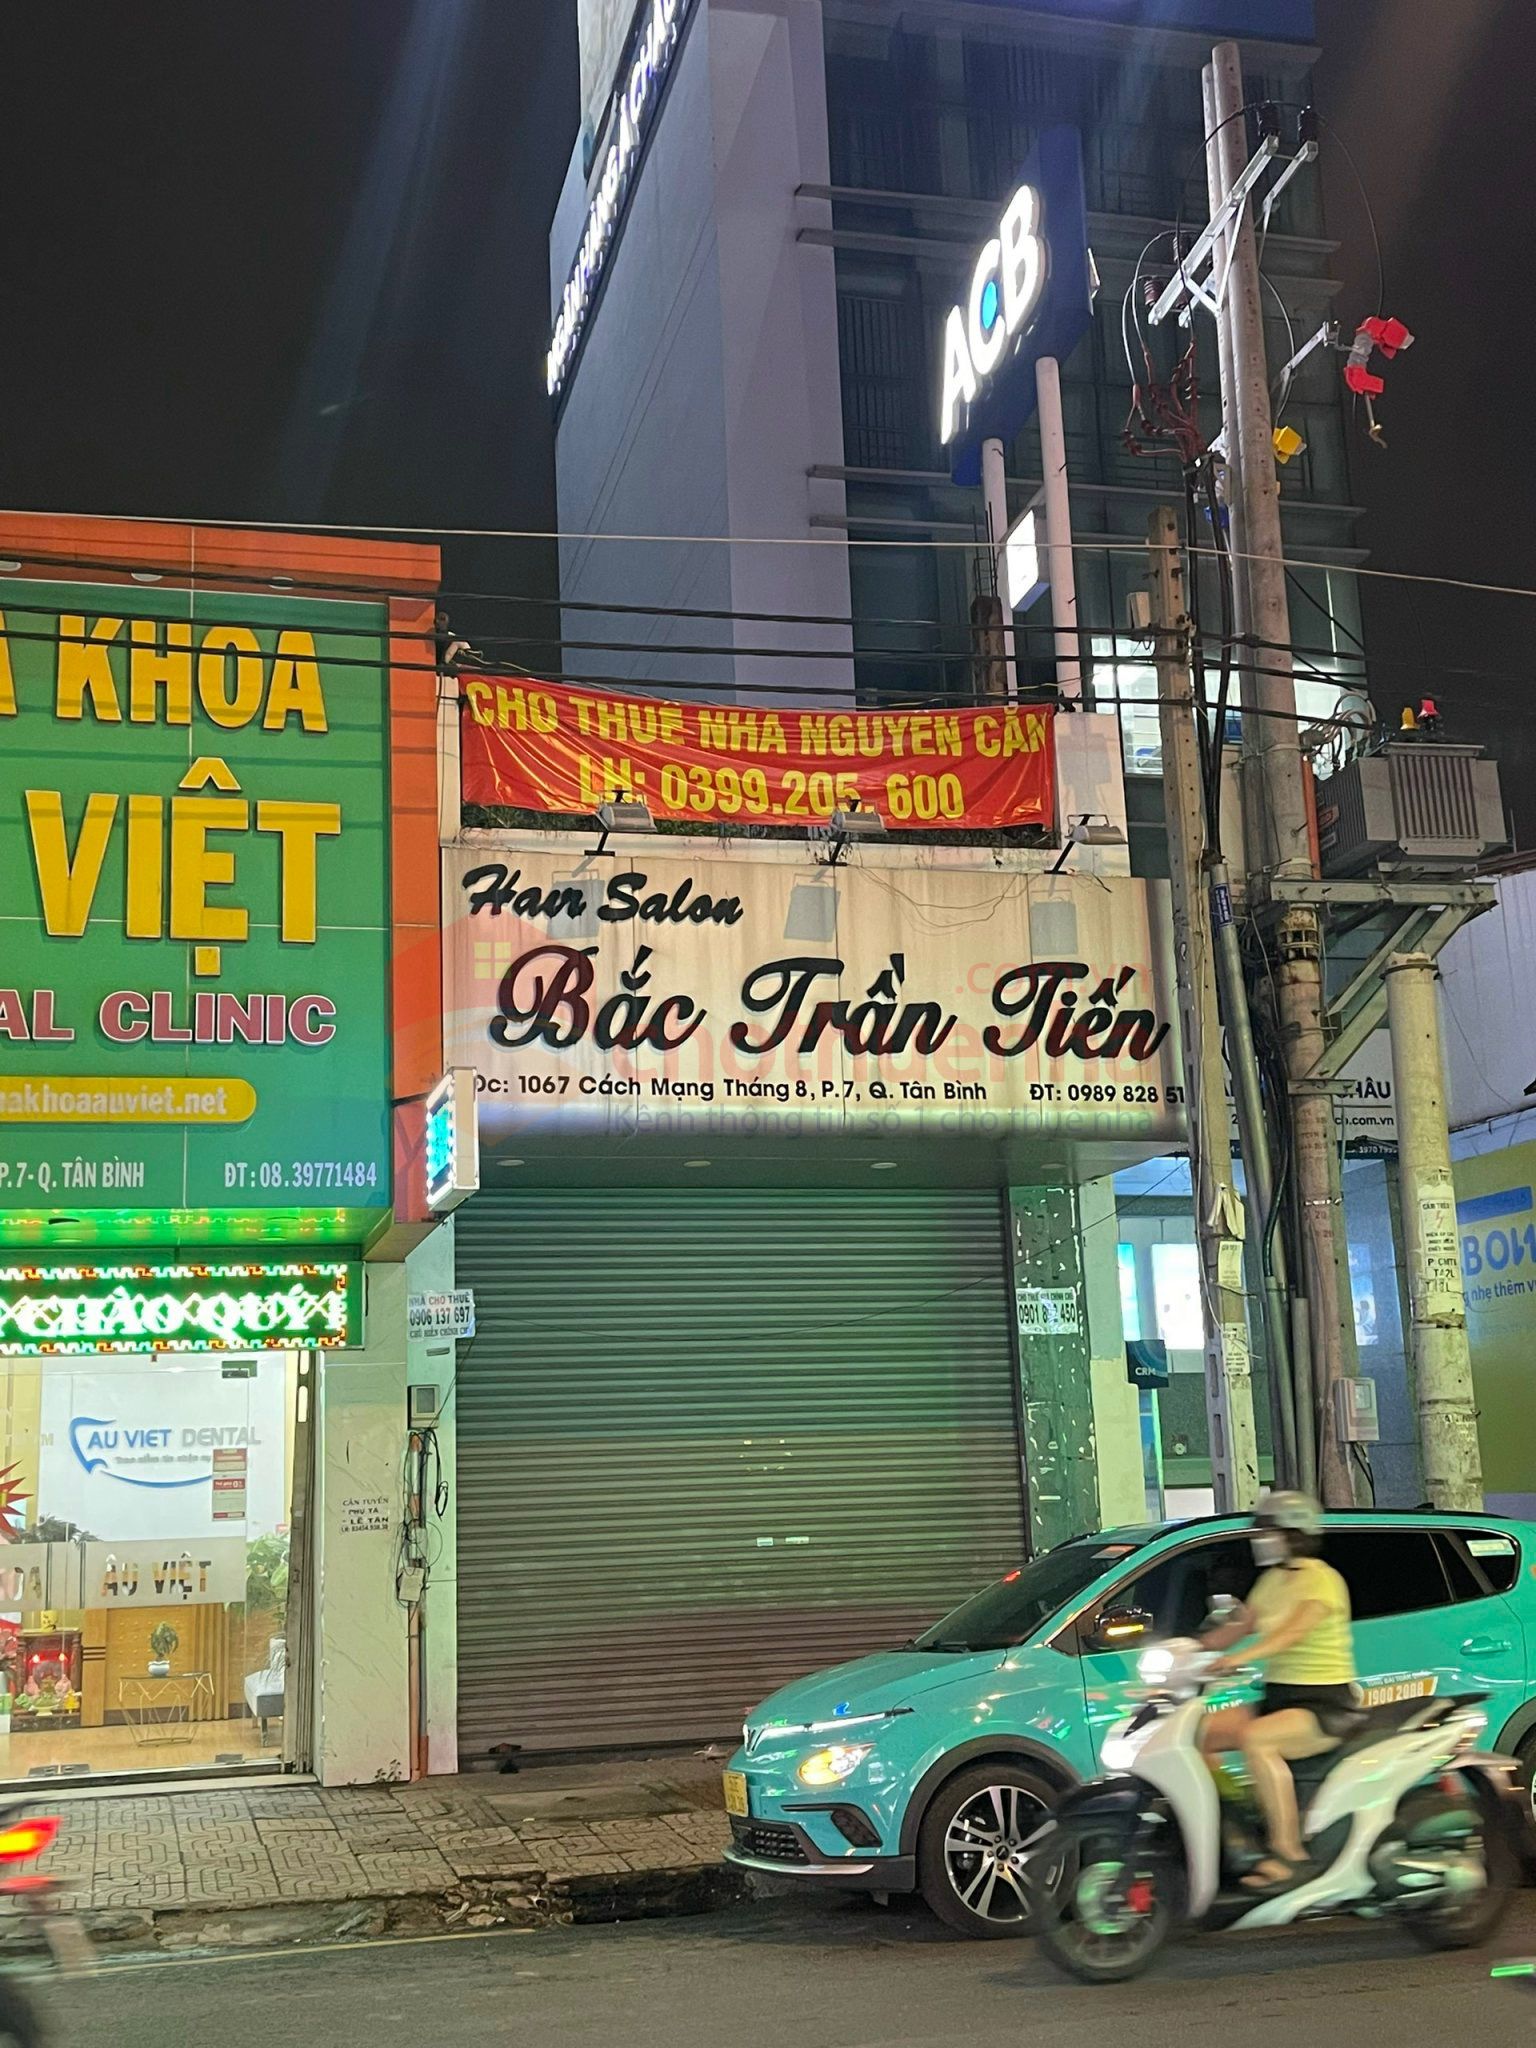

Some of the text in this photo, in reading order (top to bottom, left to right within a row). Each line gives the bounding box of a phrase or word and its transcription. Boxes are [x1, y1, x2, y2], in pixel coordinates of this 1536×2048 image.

[941, 185, 1040, 445] ACB
[57, 614, 328, 733] KHOA
[466, 682, 558, 733] CHO
[569, 700, 686, 745] THUÊ
[973, 706, 1047, 757] CĂN
[887, 774, 965, 820] 600
[25, 756, 341, 976] VIỆT
[462, 863, 744, 926] Hair Salon
[99, 990, 337, 1046] CLINIC
[488, 945, 1171, 1061] Bắc Trần Tiến
[518, 1075, 569, 1094] 1067
[578, 1073, 640, 1096] Cách
[651, 1078, 714, 1101] Mạng
[723, 1076, 789, 1101] Tháng
[796, 1081, 815, 1101] 8,
[899, 1080, 935, 1099] Tân
[944, 1079, 987, 1100] Bình
[1029, 1083, 1062, 1101] ĐT:
[1067, 1083, 1115, 1102] 0989
[1122, 1084, 1159, 1102] 828
[61, 1155, 97, 1188] TÂN
[102, 1155, 145, 1188] BÌNH
[428, 1295, 446, 1306] CHO
[1471, 1283, 1493, 1300] nhẹ
[1494, 1279, 1526, 1296] thêm
[409, 1305, 470, 1327] 0906 137 697
[1018, 1304, 1039, 1325] 0901
[1060, 1302, 1077, 1323] 450
[88, 1427, 262, 1450] AU VIET DENTAL
[101, 1553, 139, 1597] ÂU
[152, 1550, 212, 1600] VIỆT
[1368, 1686, 1394, 1706] 1900
